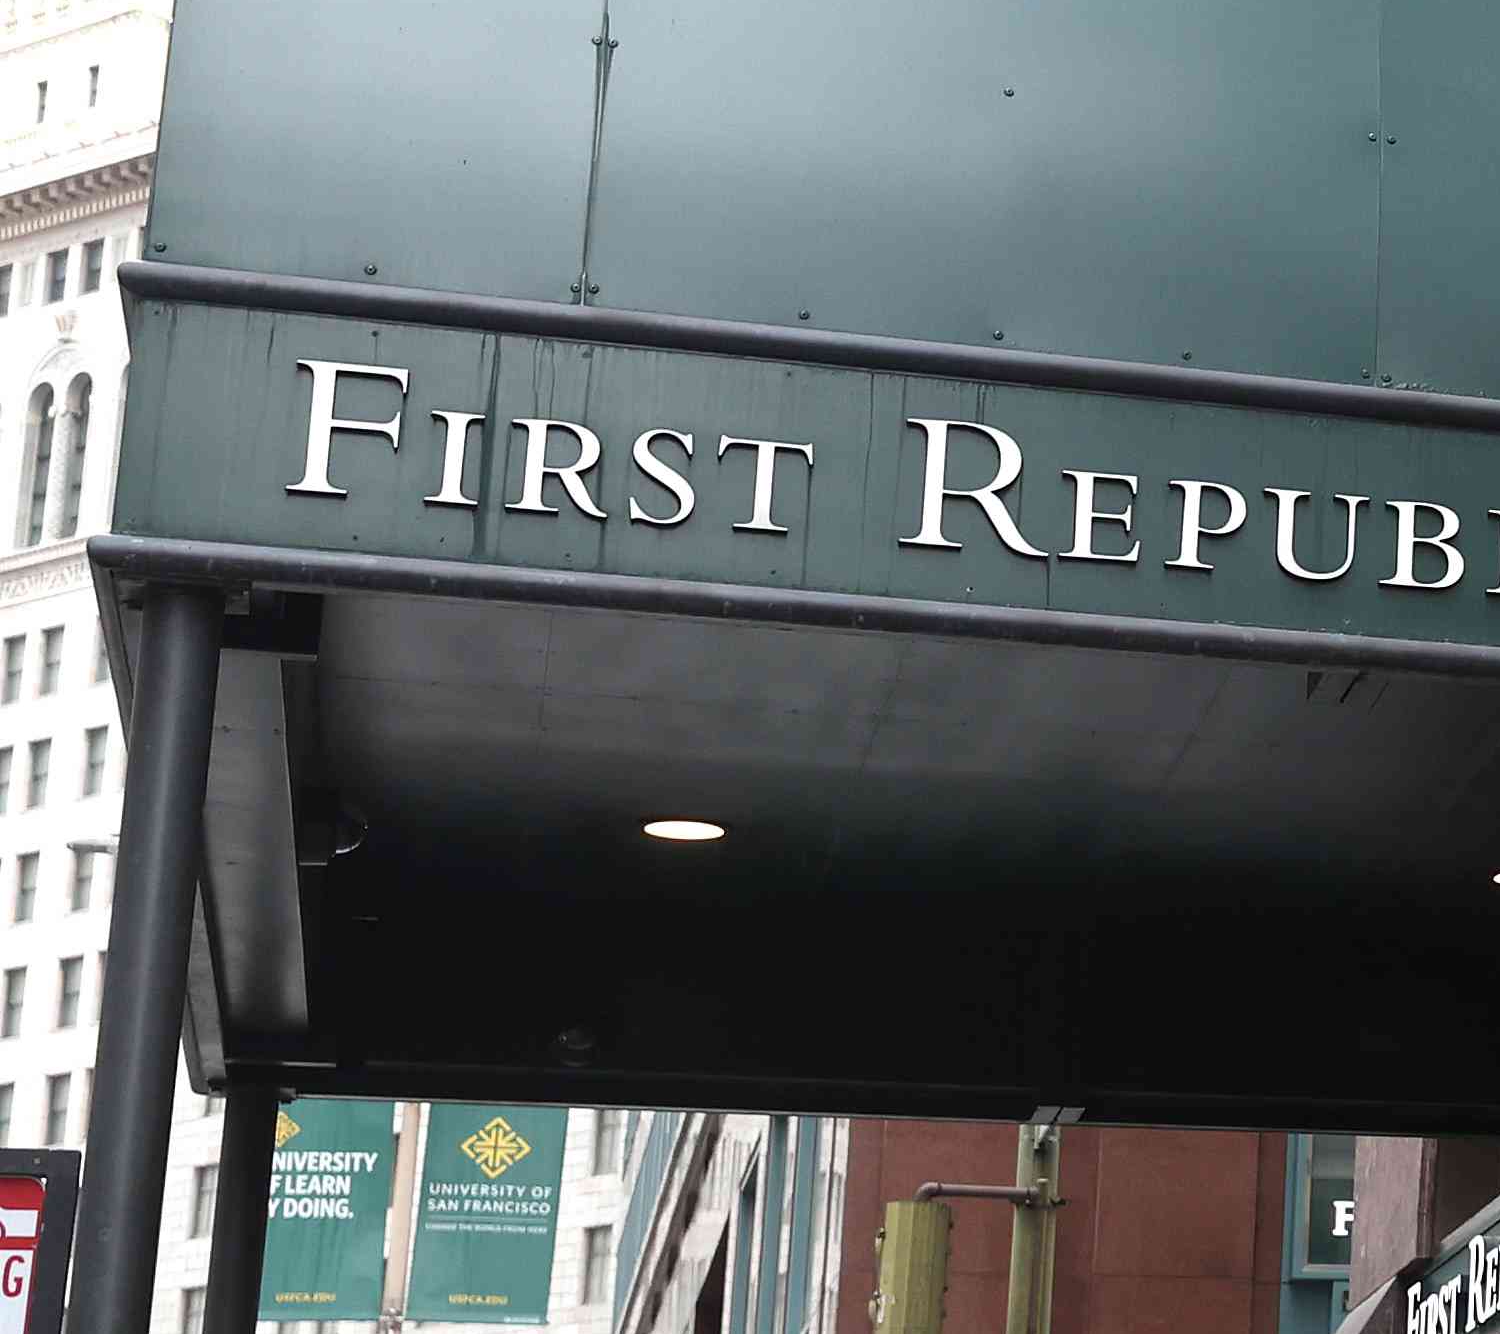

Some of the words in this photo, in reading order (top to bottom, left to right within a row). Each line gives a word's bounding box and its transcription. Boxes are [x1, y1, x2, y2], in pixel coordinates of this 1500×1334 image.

[284, 358, 814, 532] FIRST
[272, 1151, 379, 1173] NIVERSITY
[284, 1174, 351, 1196] LEARN
[429, 1182, 527, 1198] UNIVERSITY
[531, 1186, 552, 1199] OF
[282, 1197, 354, 1219] DOING.
[428, 1198, 459, 1212] SAN
[463, 1200, 551, 1214] FRANCISCO
